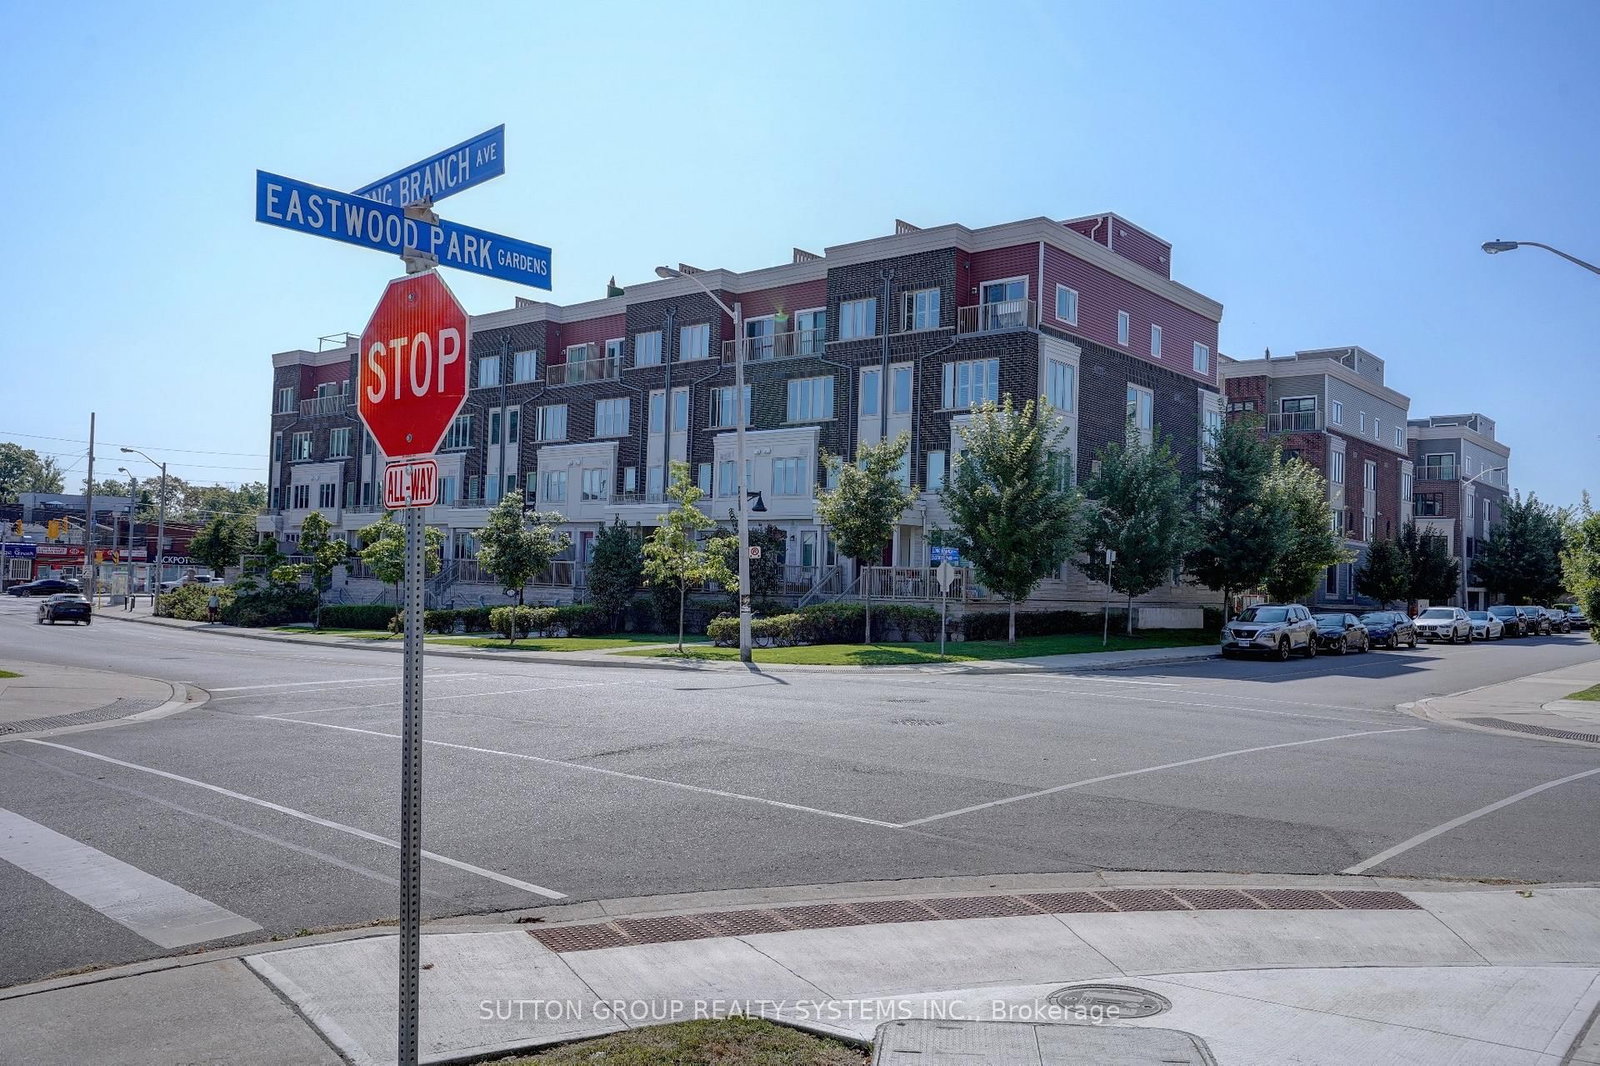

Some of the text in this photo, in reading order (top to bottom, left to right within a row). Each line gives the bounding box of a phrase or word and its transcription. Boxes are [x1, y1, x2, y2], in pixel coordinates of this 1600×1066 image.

[400, 147, 469, 206] BRANCH
[475, 142, 497, 168] AVE
[266, 182, 547, 276] EASTWOOD PARK GARDENS
[366, 327, 461, 404] STOP
[388, 466, 433, 502] ALL-WAY
[153, 555, 190, 564] JCKPOT
